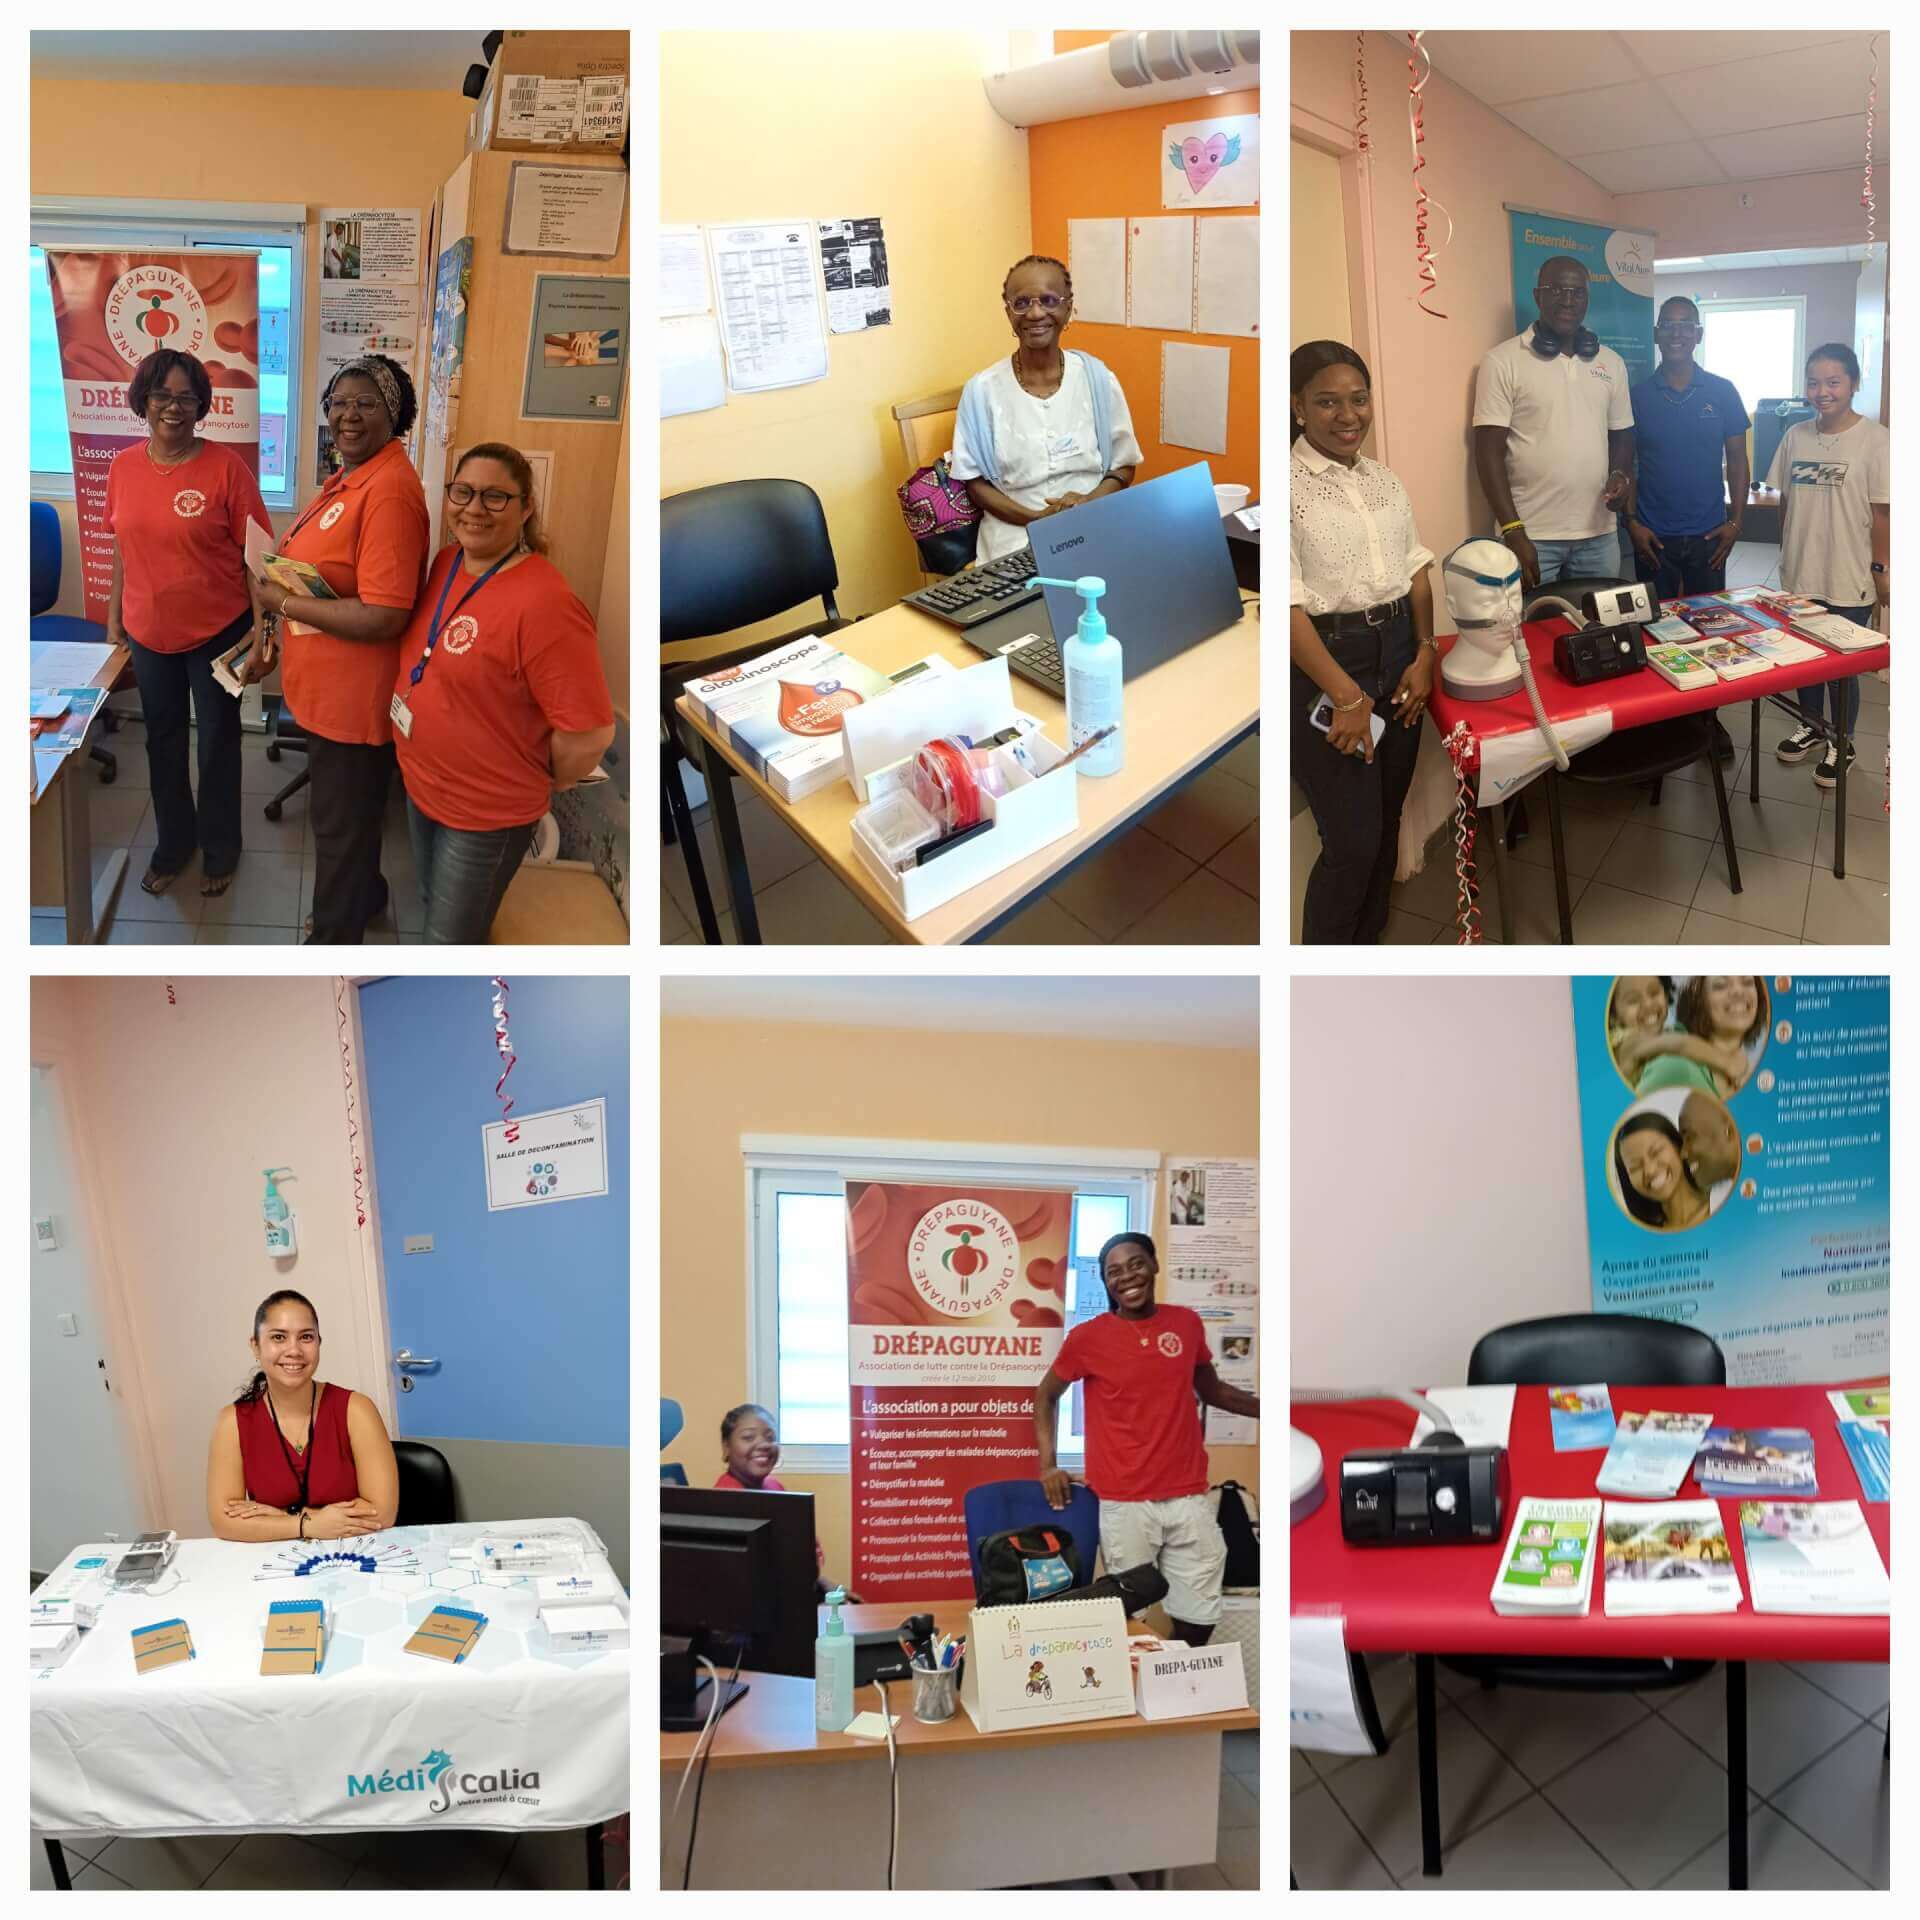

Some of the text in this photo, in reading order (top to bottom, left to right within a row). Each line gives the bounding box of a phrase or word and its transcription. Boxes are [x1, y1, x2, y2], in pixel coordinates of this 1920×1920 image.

[1524, 229, 1577, 250] Ensemble
[109, 270, 200, 316] DRÉPAGUYANE
[72, 411, 117, 422] Association
[118, 414, 129, 422] de
[1049, 535, 1085, 555] Lenovo
[700, 643, 819, 694] Globinoscope
[797, 697, 829, 716] Fer
[496, 1151, 516, 1160] SALLE
[527, 1137, 595, 1155] DECONTAMINATION
[913, 1204, 1014, 1252] DRÉPAGUYANE
[1643, 1257, 1657, 1269] du
[1660, 1248, 1709, 1265] sommeil
[1823, 1244, 1873, 1259] Nutrition
[914, 1267, 1015, 1313] DRÉPAGUYANE
[1603, 1286, 1666, 1303] Ventilation
[873, 1331, 1042, 1357] DRÉPAGUYANE
[858, 1361, 989, 1371] Association de lutte contre la
[942, 1375, 950, 1383] le
[951, 1375, 960, 1383] 12
[961, 1375, 976, 1383] mai
[977, 1375, 997, 1383] 2010
[862, 1399, 939, 1415] L'association
[940, 1402, 948, 1414] a
[950, 1402, 979, 1417] pour
[980, 1398, 1019, 1417] objets
[869, 1428, 1007, 1442] Vulgariser les informations sur la maladie
[899, 1449, 945, 1461] accompagner
[945, 1447, 956, 1457] les
[956, 1447, 984, 1458] malades
[869, 1460, 916, 1471] et leur famille
[869, 1477, 945, 1491] Démystifier la maladie
[869, 1496, 953, 1508] Sensibiliser au dépistage
[869, 1514, 957, 1527] Collecter des fonds afin de
[868, 1531, 961, 1545] Promouvoir la formation de
[868, 1551, 944, 1565] Pratiquer des Activités
[868, 1569, 944, 1583] Organiser des activités
[1002, 1635, 1113, 1660] La drépanocytose
[1154, 1655, 1224, 1676] DREPA-GUYANE
[456, 1798, 481, 1807] Votre
[482, 1795, 508, 1805] santé
[509, 1795, 516, 1803] à
